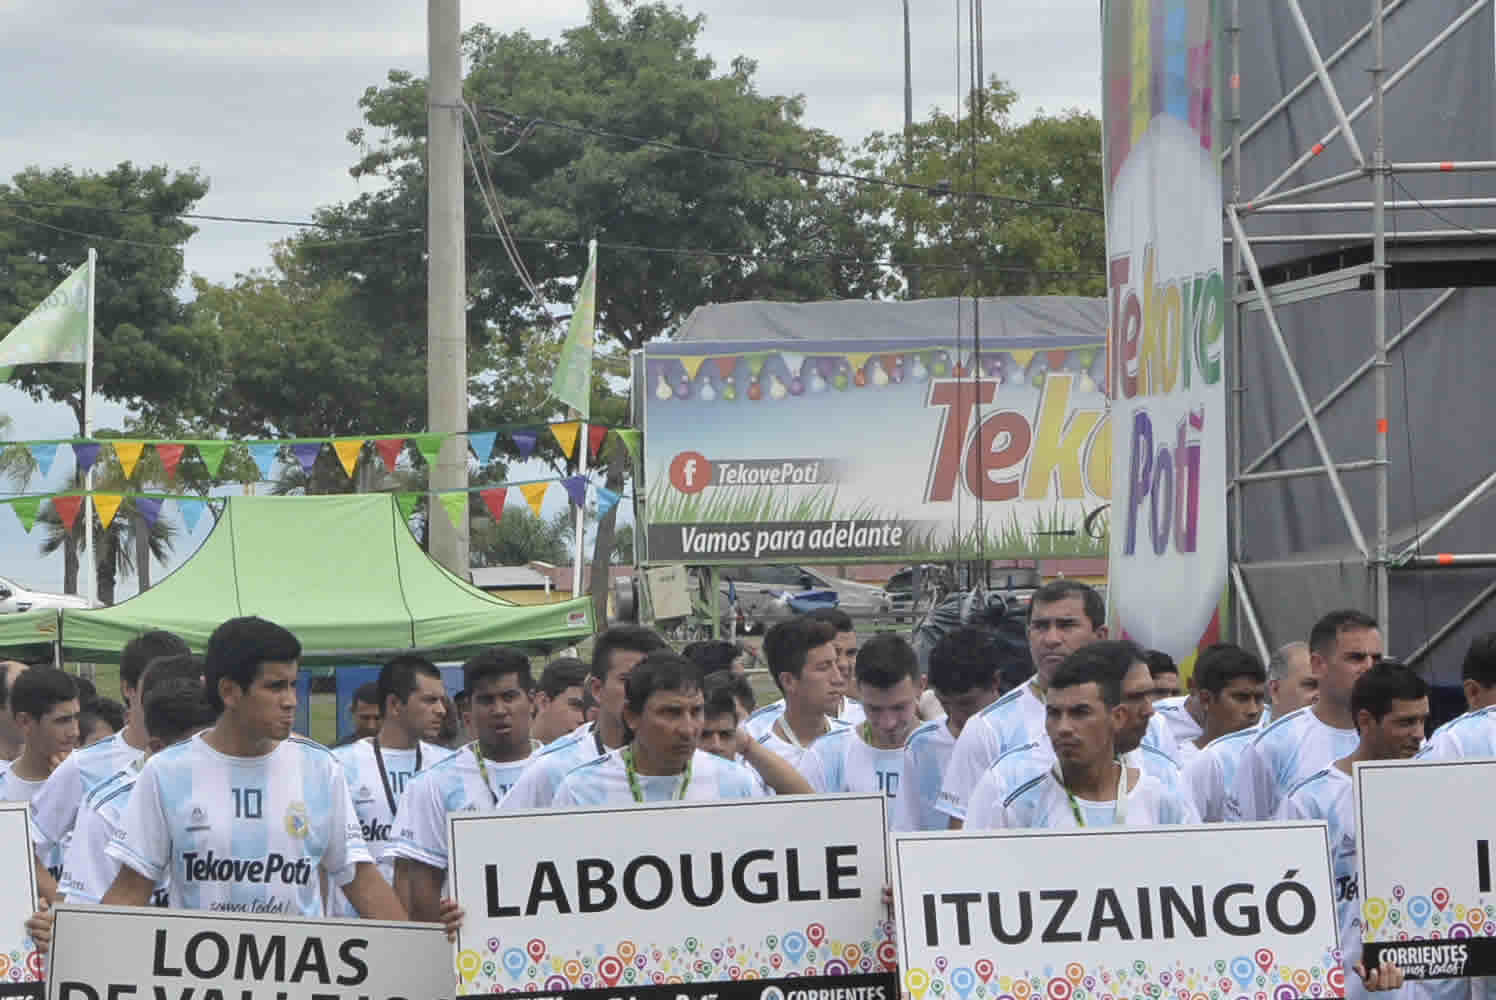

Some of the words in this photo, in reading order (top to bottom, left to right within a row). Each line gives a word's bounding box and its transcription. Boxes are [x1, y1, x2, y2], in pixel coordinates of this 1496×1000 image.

[681, 526, 751, 553] Vamos
[755, 530, 806, 558] para
[808, 522, 903, 549] adelante
[232, 788, 262, 820] 10
[485, 845, 861, 918] LABOUGLE
[923, 870, 1316, 947] ITUZAINGÓ
[153, 928, 369, 986] LOMAS
[1379, 944, 1468, 967] CORRIENTES
